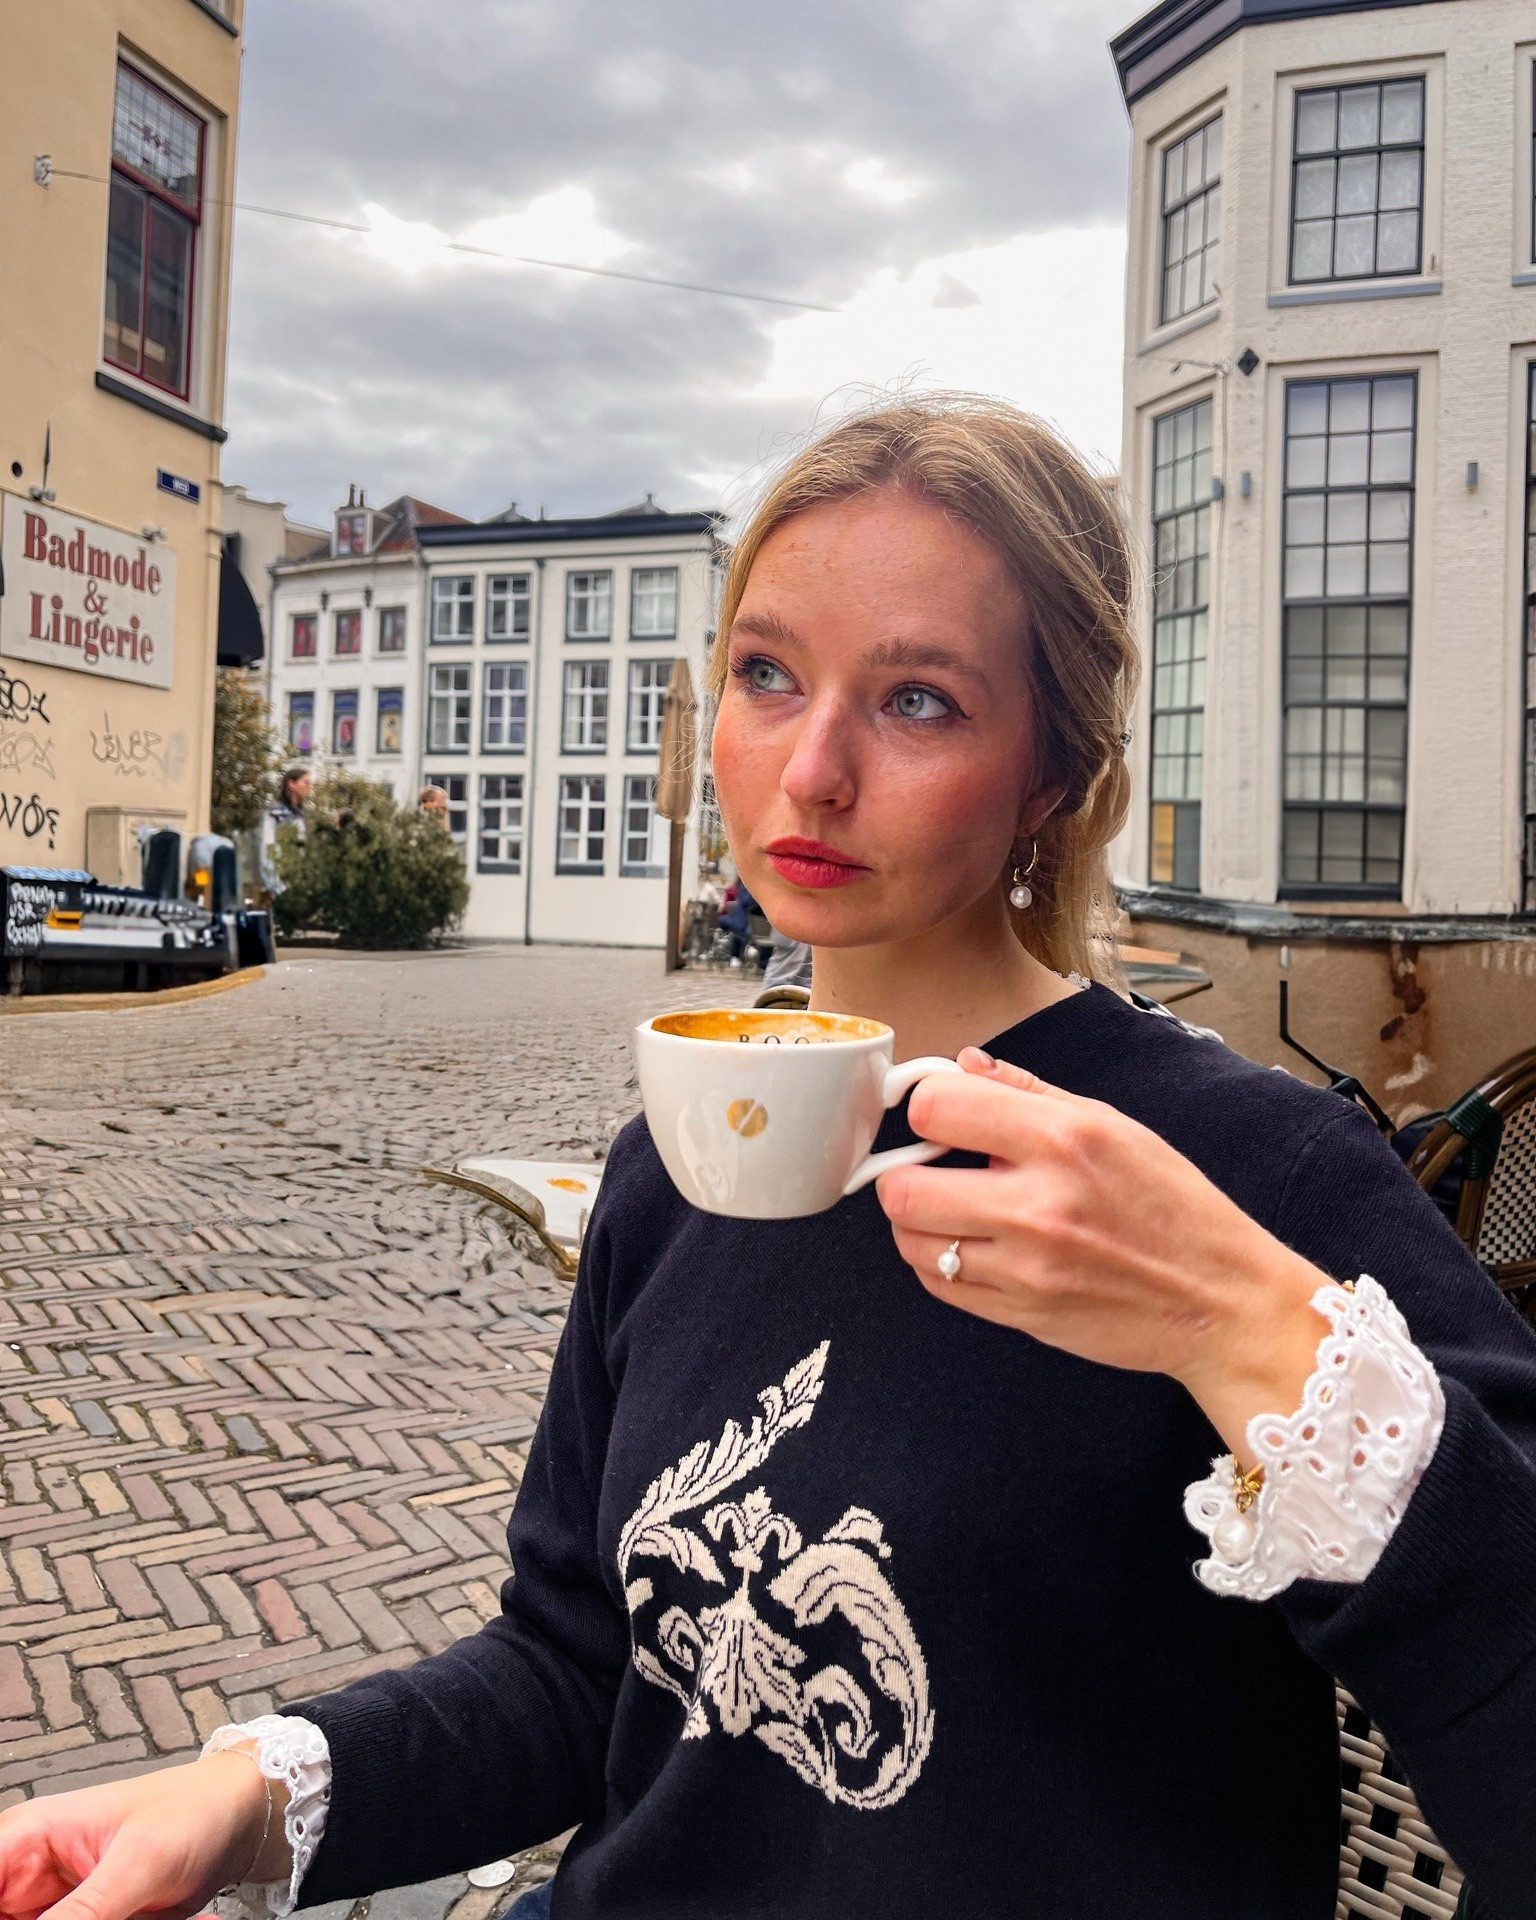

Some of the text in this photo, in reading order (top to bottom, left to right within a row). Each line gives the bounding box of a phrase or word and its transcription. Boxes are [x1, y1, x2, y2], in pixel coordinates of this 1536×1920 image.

[23, 511, 161, 595] Badmode
[29, 591, 155, 665] Lingerie
[83, 579, 109, 616] &
